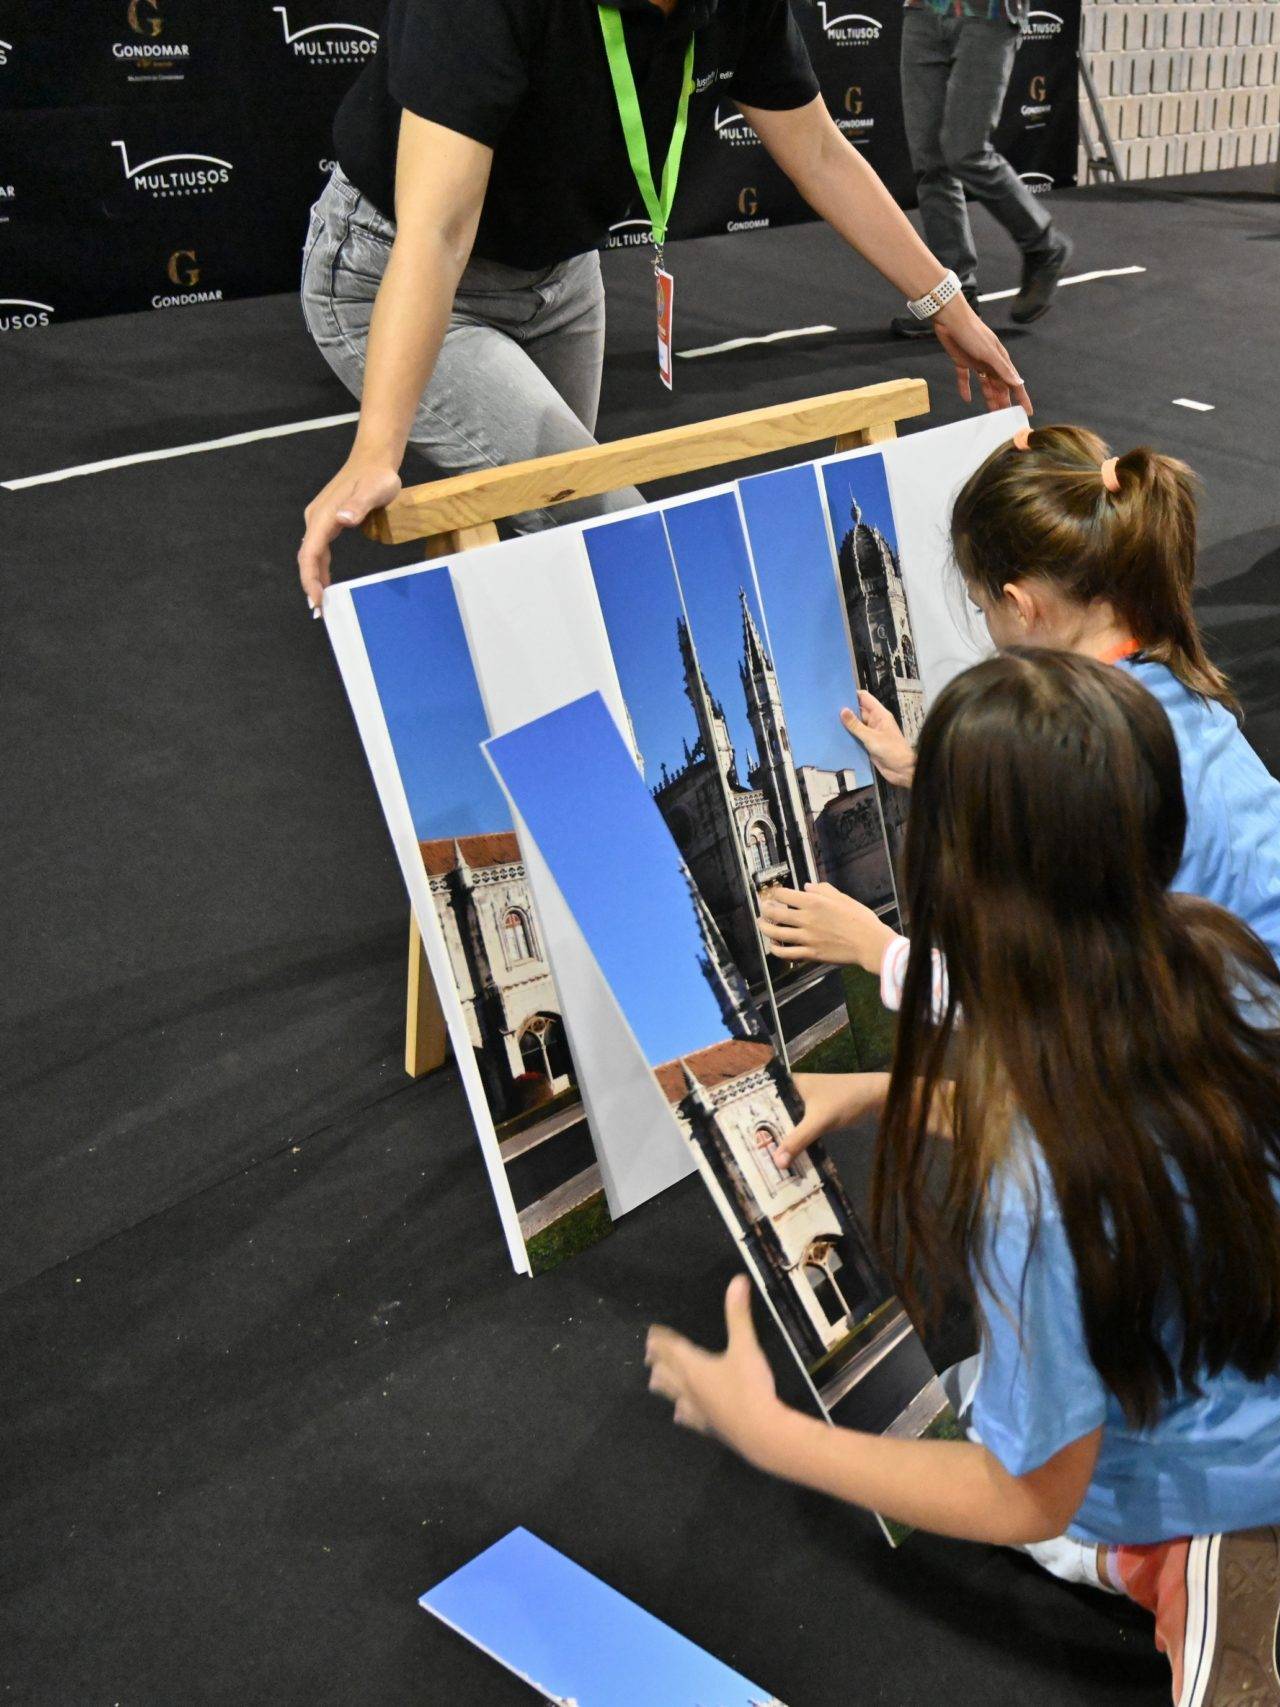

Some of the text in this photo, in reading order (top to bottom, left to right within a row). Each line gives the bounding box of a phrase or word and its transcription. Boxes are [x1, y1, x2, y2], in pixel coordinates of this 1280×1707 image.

[827, 27, 880, 40] MULTIUSOS
[1022, 22, 1062, 35] ULTIUSOS
[112, 42, 190, 58] GONDOMAR
[294, 40, 378, 56] MULTIUSOS
[134, 168, 230, 191] MULTIUSOS
[151, 289, 223, 309] GONDOMAR
